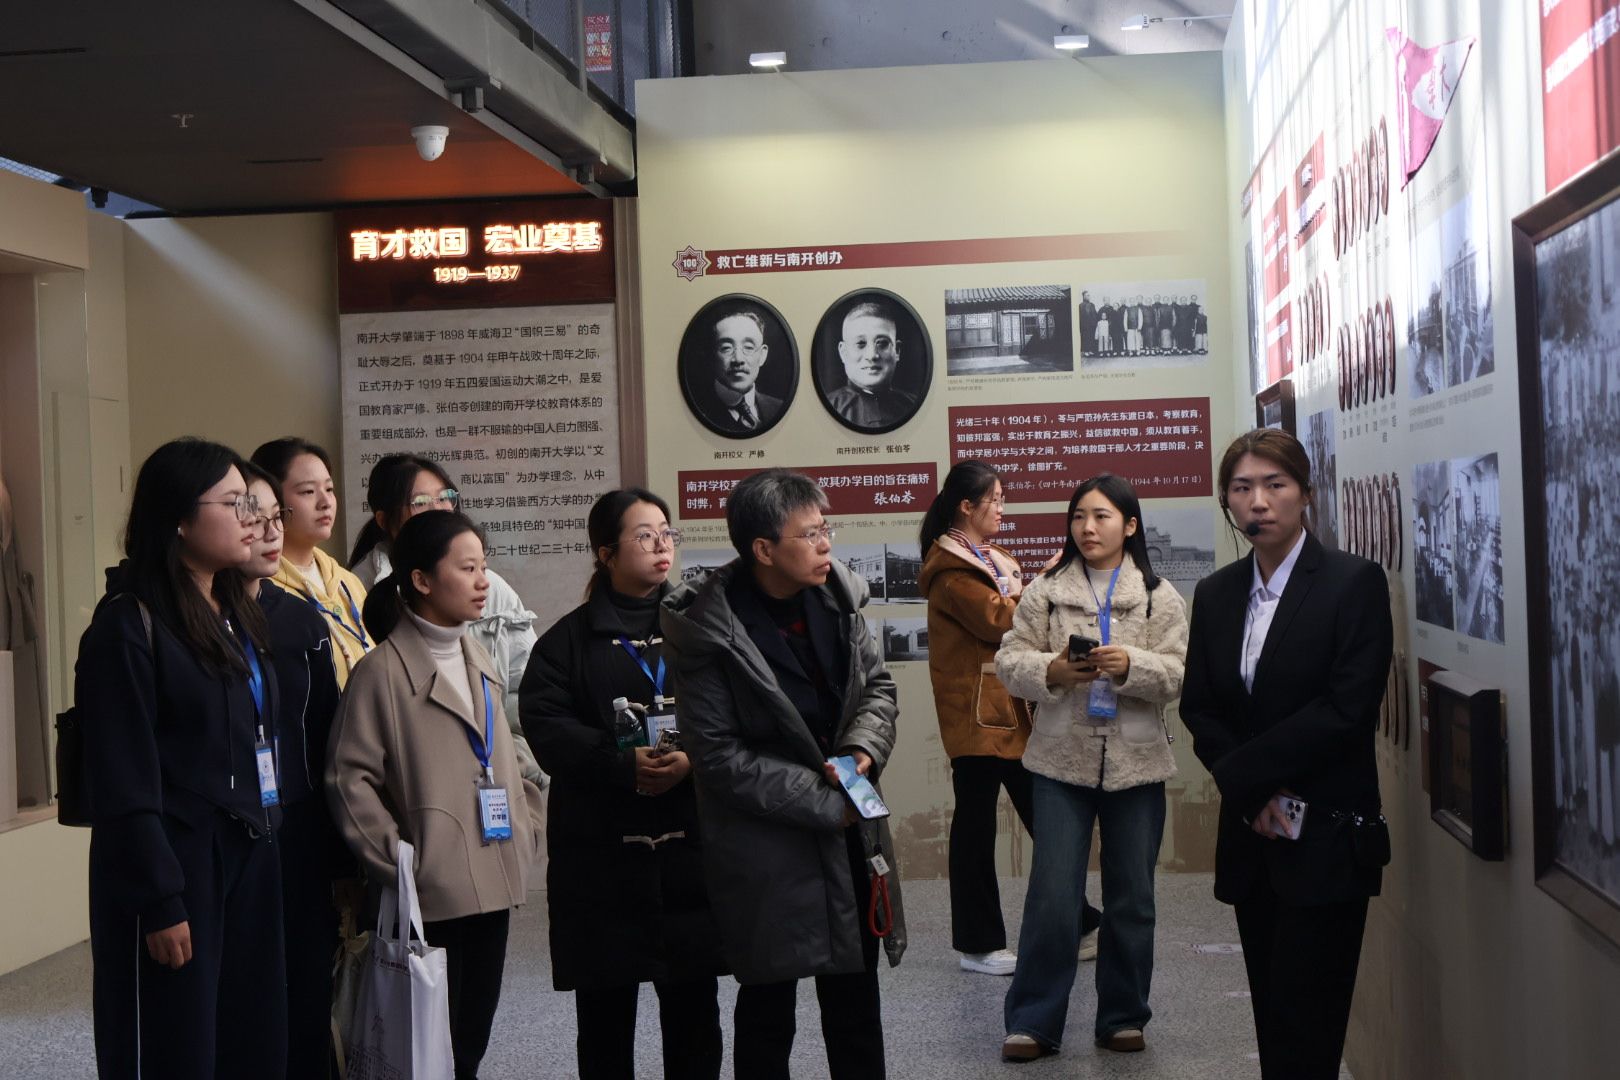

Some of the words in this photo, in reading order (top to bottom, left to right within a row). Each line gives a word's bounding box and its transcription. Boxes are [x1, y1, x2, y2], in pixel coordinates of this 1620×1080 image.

[351, 227, 469, 261] 育才救国
[484, 220, 602, 253] 宏业奠基
[717, 251, 843, 270] 救亡维新与南开创办
[461, 493, 599, 509] 性地学习借鉴西方大学的办
